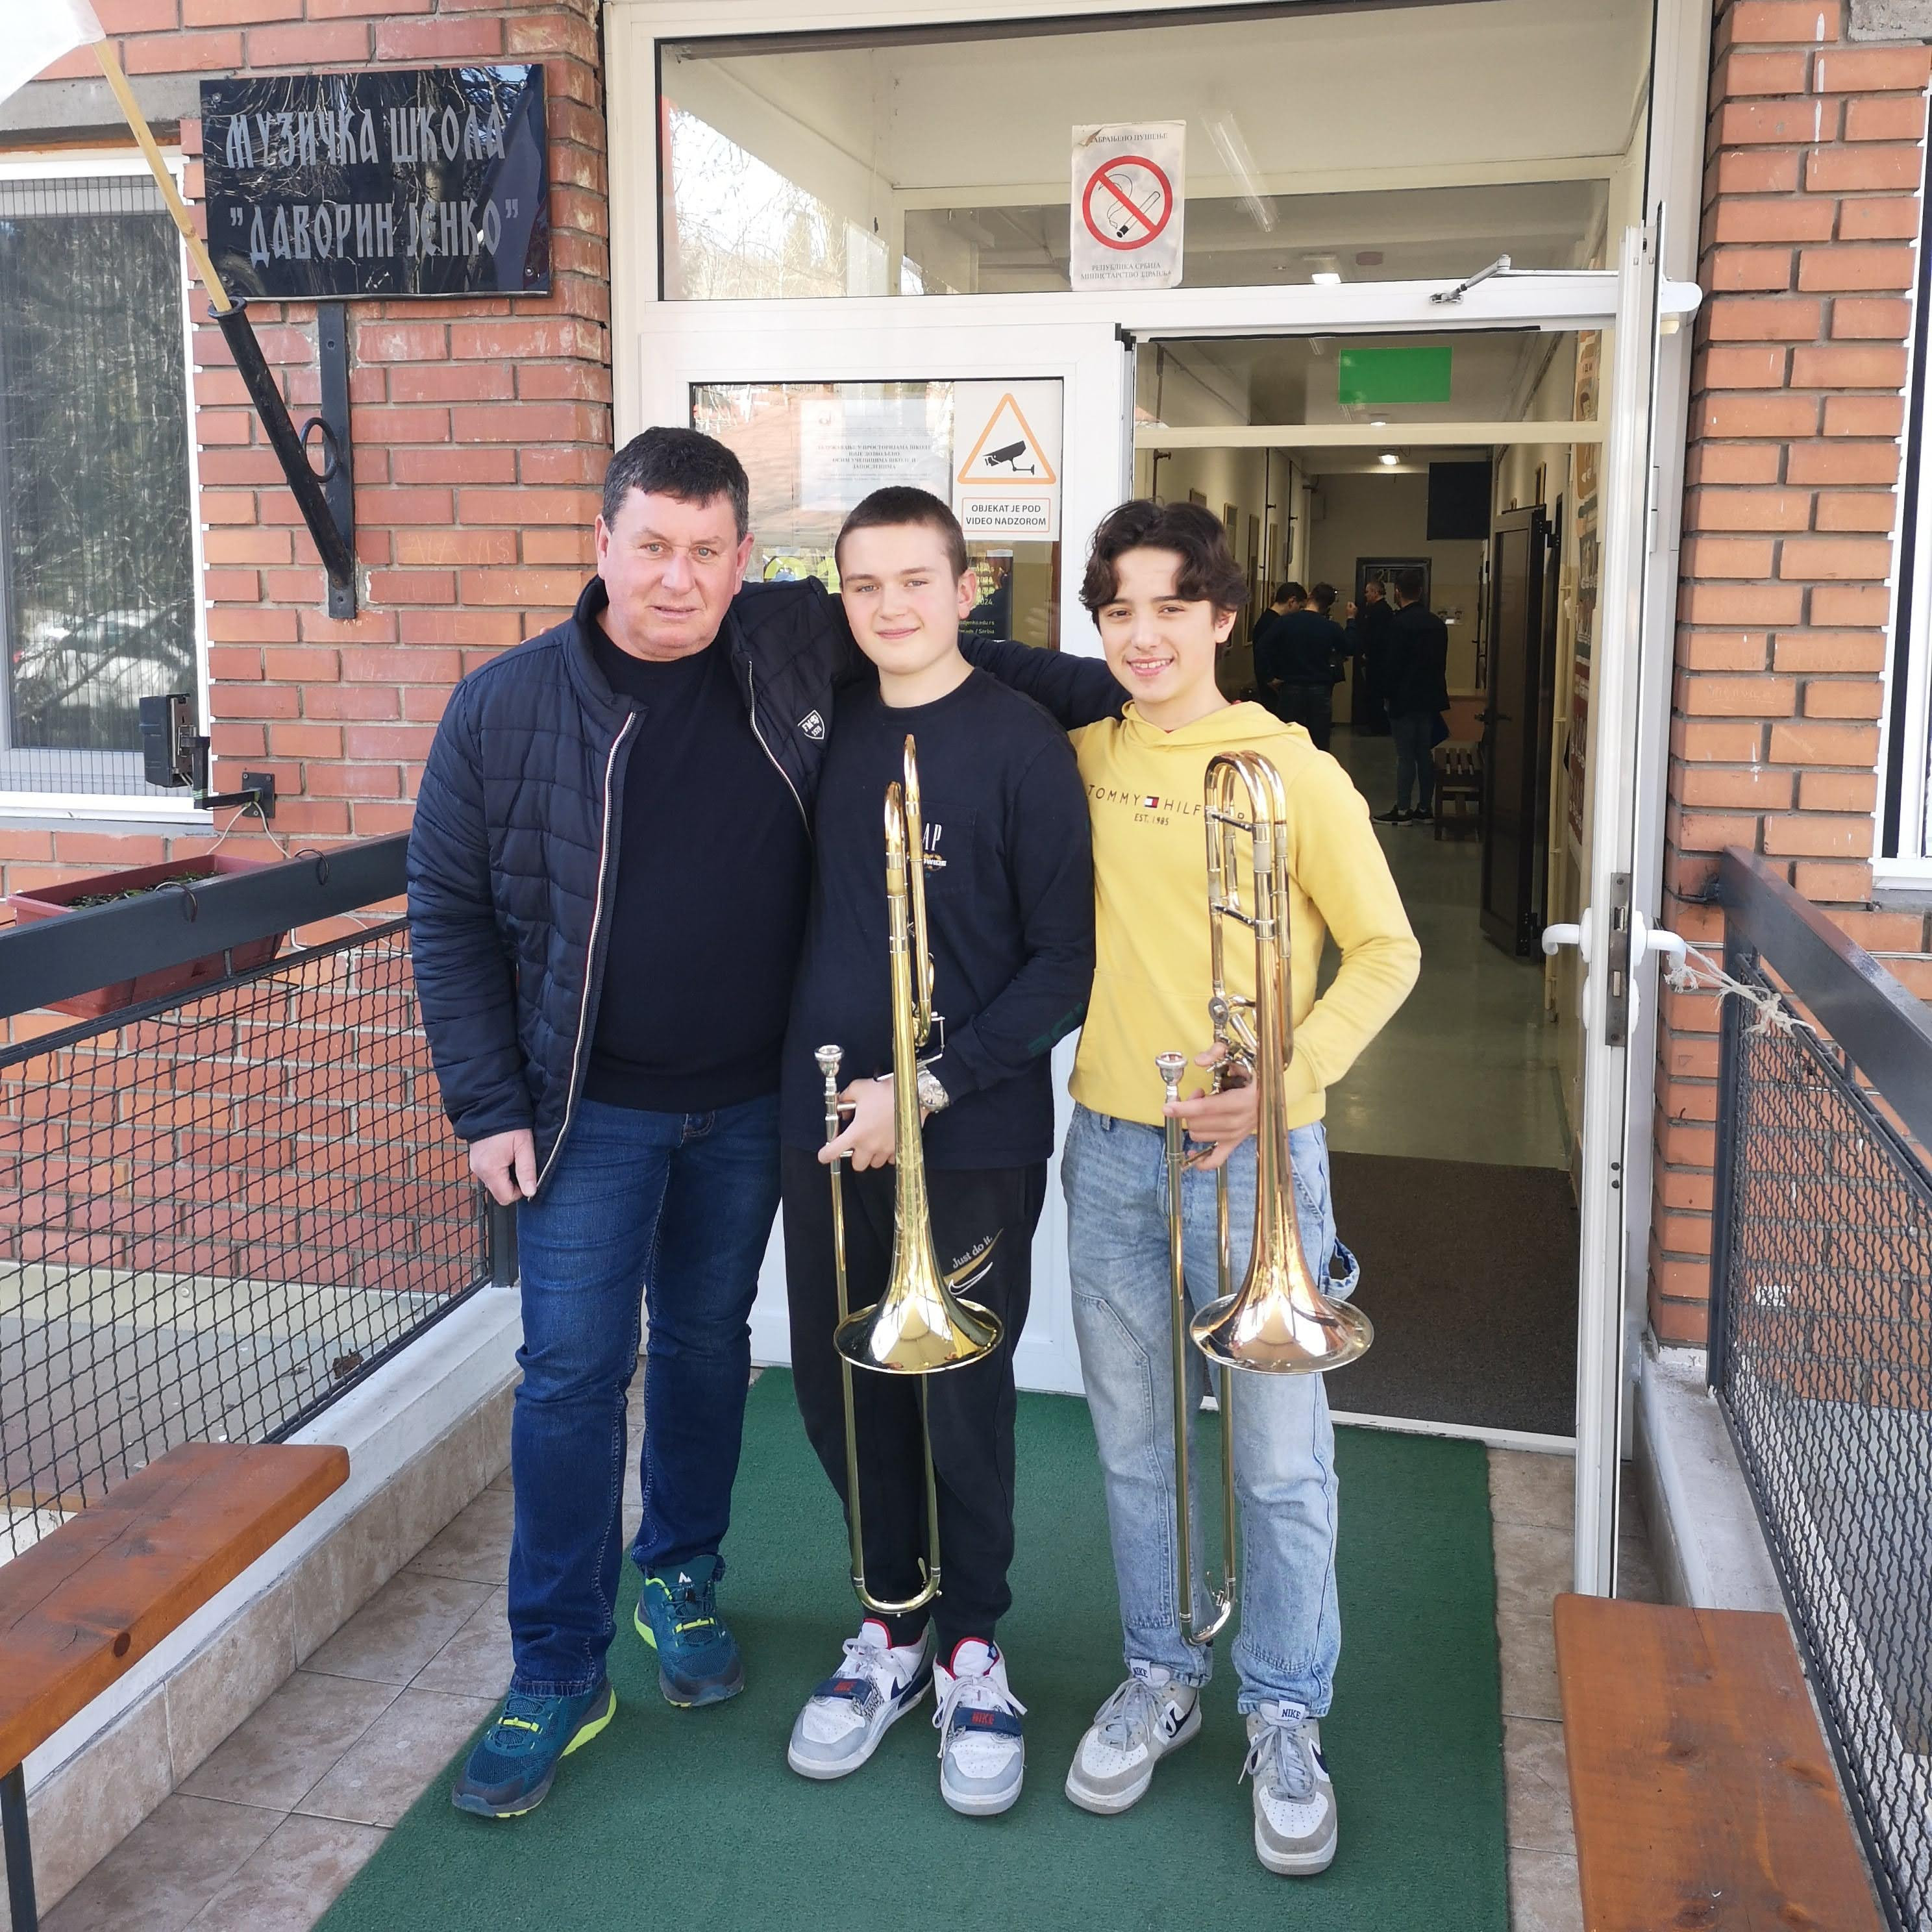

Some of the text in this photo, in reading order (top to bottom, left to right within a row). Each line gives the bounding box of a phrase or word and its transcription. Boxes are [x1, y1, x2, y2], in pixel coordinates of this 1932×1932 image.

[226, 105, 506, 169] МУЗИЧКА ШКОЛА
[1090, 134, 1132, 143] АБРАЊЕНО
[1081, 271, 1139, 280] МИНИСТАРСТВО
[1088, 784, 1141, 806] TOMMY
[1134, 813, 1169, 826] EST. 1985
[923, 823, 942, 851] AP
[952, 1252, 972, 1269] Just
[972, 1244, 984, 1256] do
[1132, 1667, 1148, 1678] NIKE
[1282, 1709, 1301, 1720] NIKE
